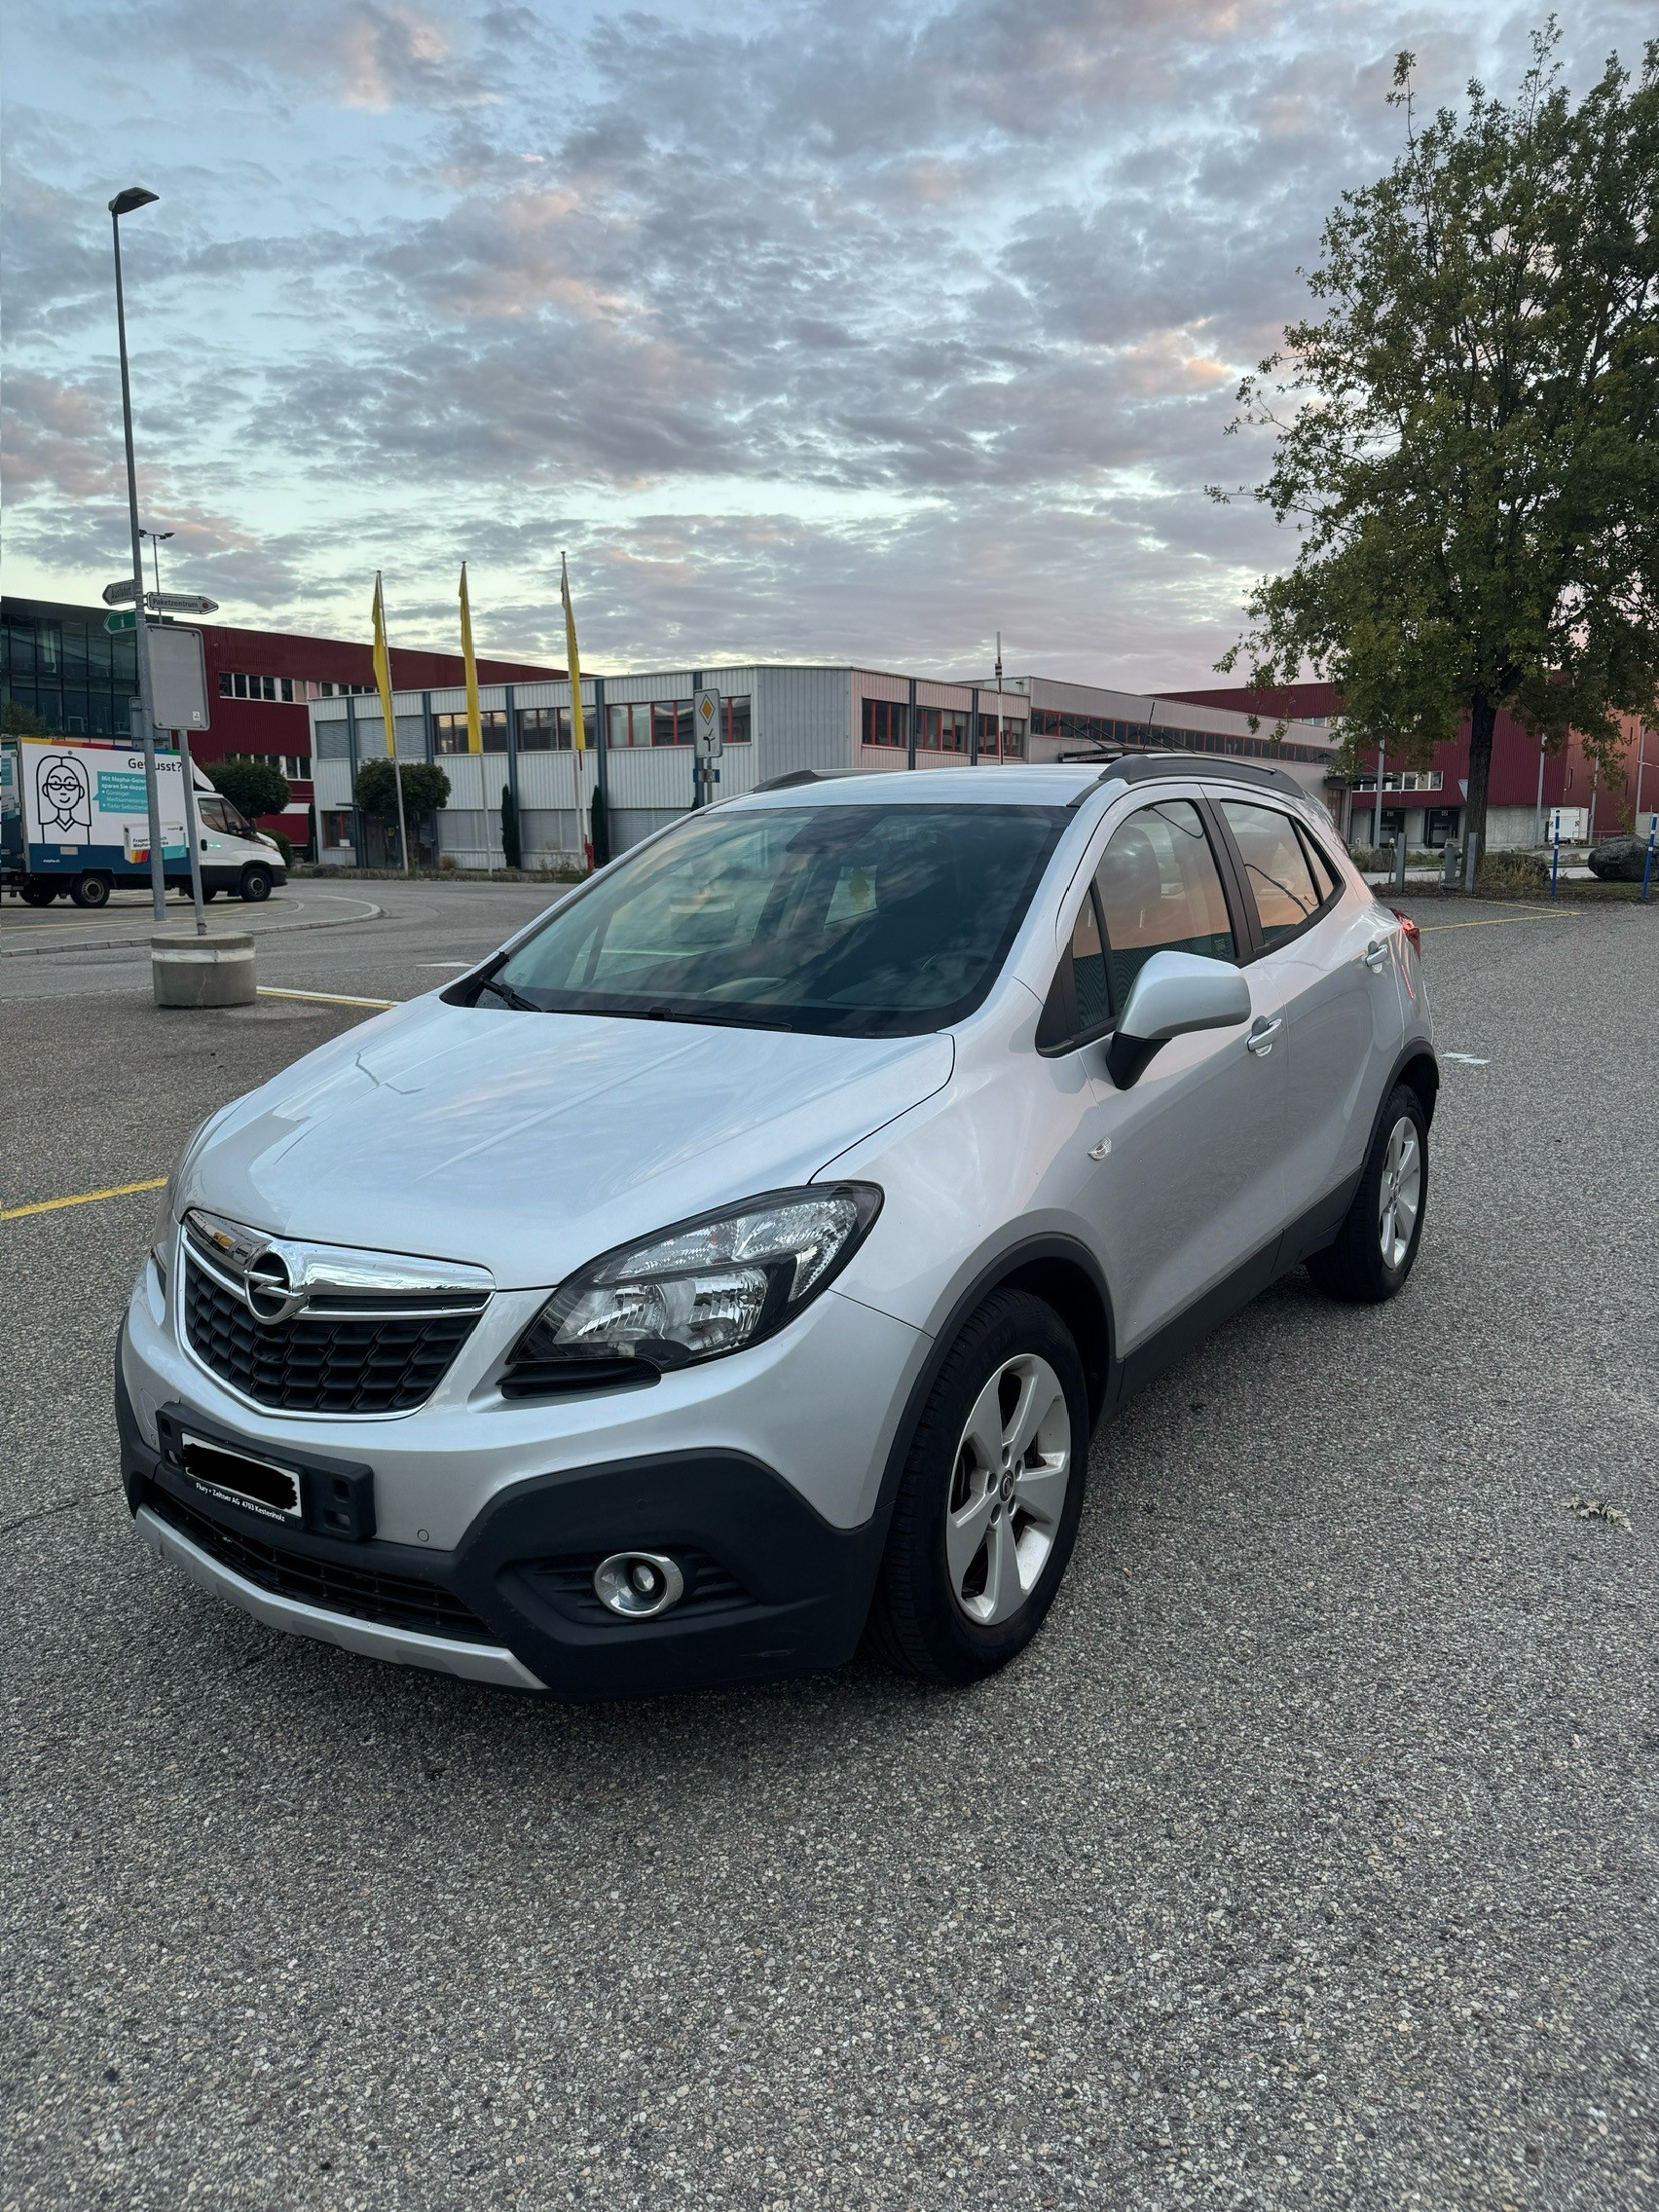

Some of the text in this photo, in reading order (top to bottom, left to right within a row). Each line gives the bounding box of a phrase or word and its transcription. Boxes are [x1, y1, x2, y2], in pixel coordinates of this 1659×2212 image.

[152, 597, 199, 608] Paketzentrum
[128, 757, 182, 772] Geusst?
[232, 1496, 240, 1506] AG
[241, 1500, 255, 1511] 4703
